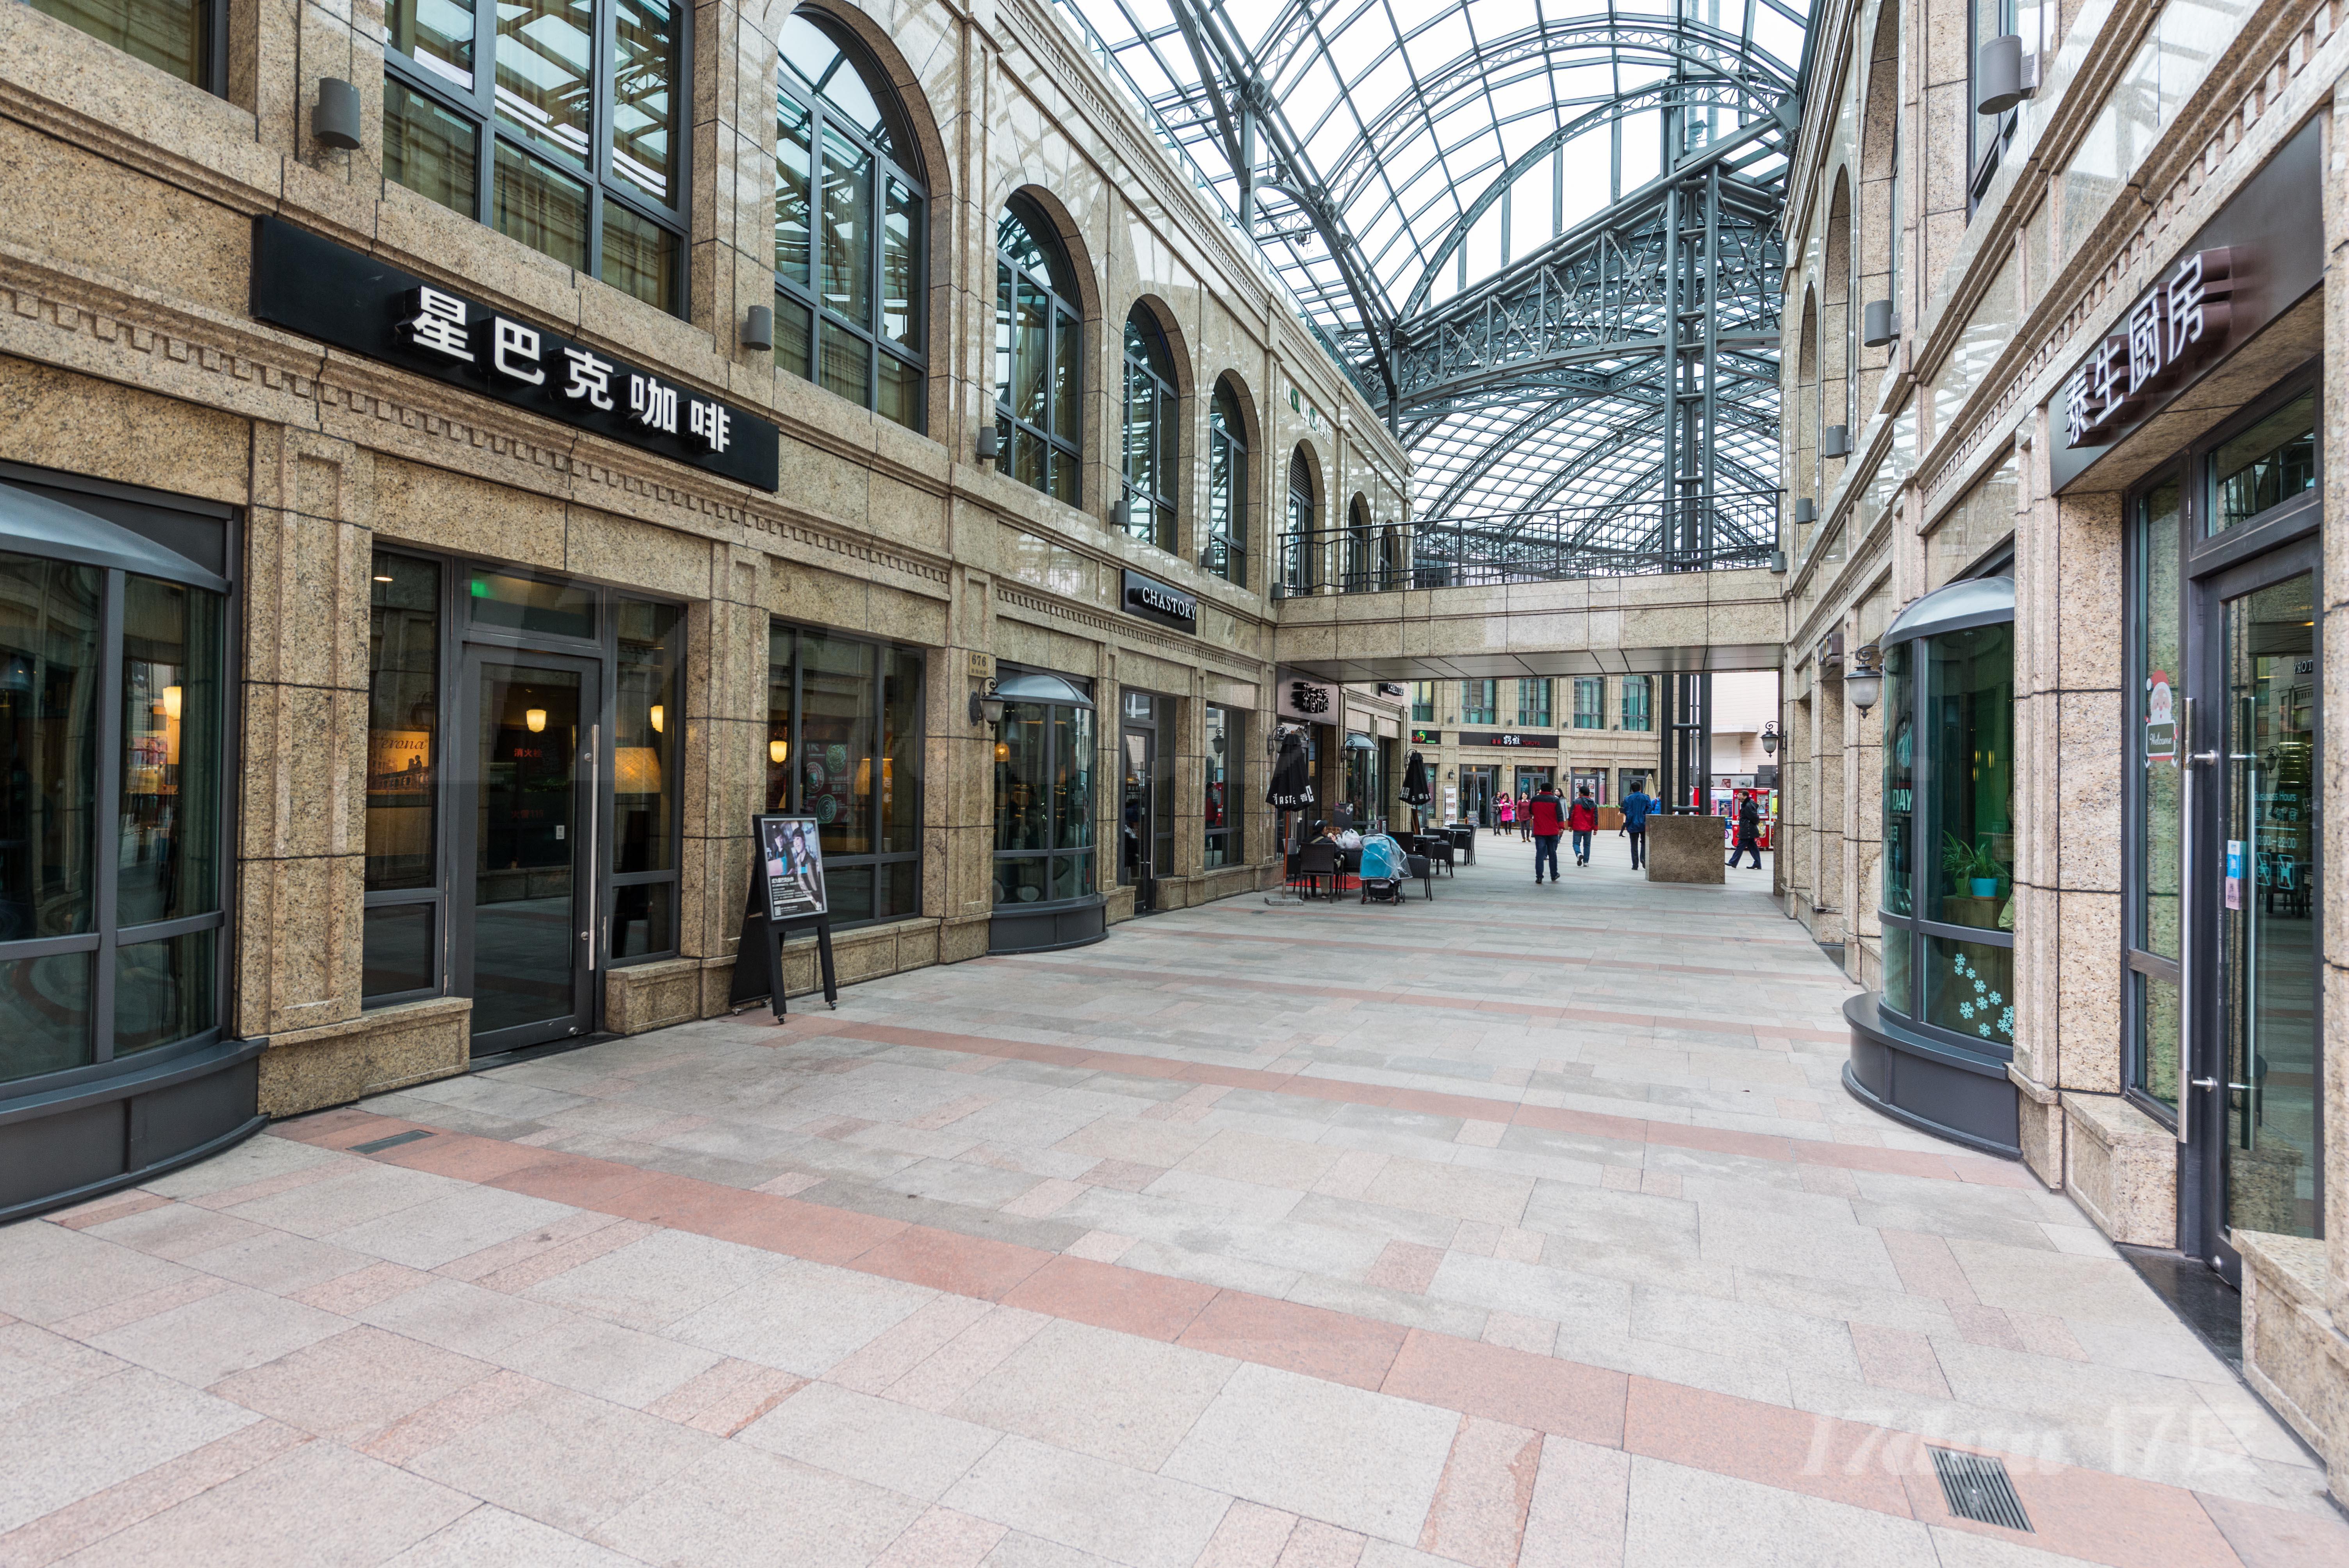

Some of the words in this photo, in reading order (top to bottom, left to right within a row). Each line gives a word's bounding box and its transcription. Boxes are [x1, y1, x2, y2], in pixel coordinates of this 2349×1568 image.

[2065, 253, 2205, 447] 泰生厨房
[412, 285, 731, 454] 星巴克咖啡
[1142, 587, 1197, 620] CHASTORY
[972, 654, 986, 667] 676
[1303, 683, 1330, 713] 茶香书香
[2149, 732, 2172, 745] Welcome
[514, 748, 542, 757] 消火栓
[2279, 790, 2297, 801] Hours
